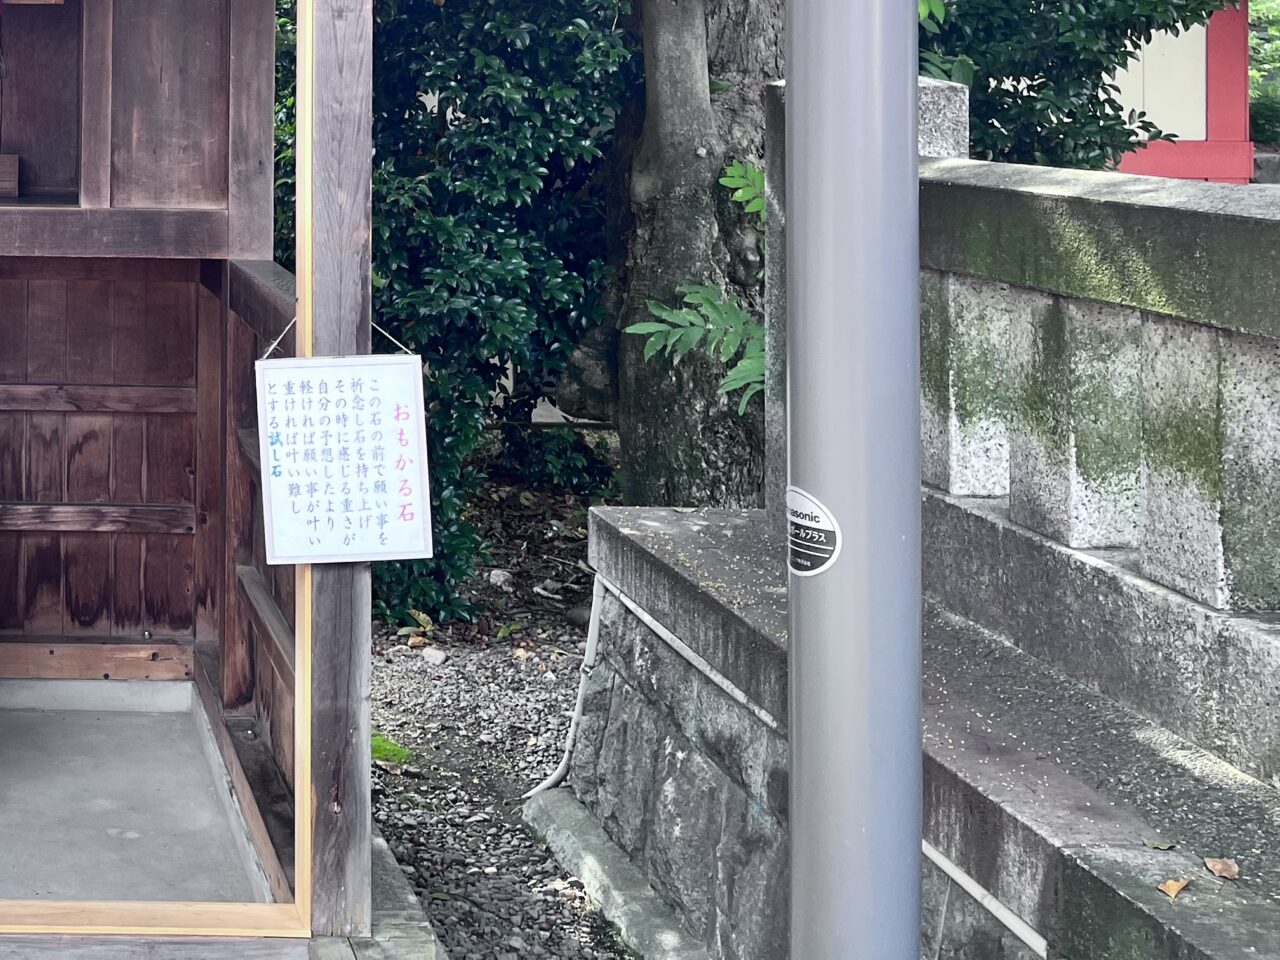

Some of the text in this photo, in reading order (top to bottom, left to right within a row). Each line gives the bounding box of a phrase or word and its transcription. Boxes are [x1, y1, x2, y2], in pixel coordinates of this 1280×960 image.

[266, 382, 284, 478] とする試し石
[283, 380, 303, 515] 重ければ叶い難し
[299, 380, 321, 546] 軽ければ願い事が叶い
[317, 379, 336, 532] 自分の予想したより
[335, 379, 356, 546] その時に感じる重さが
[349, 378, 372, 529] 祈念し石を持ち上げ
[369, 379, 389, 546] この石の前で願い事を
[393, 403, 415, 522] おもかる石
[789, 507, 820, 523] asonic
